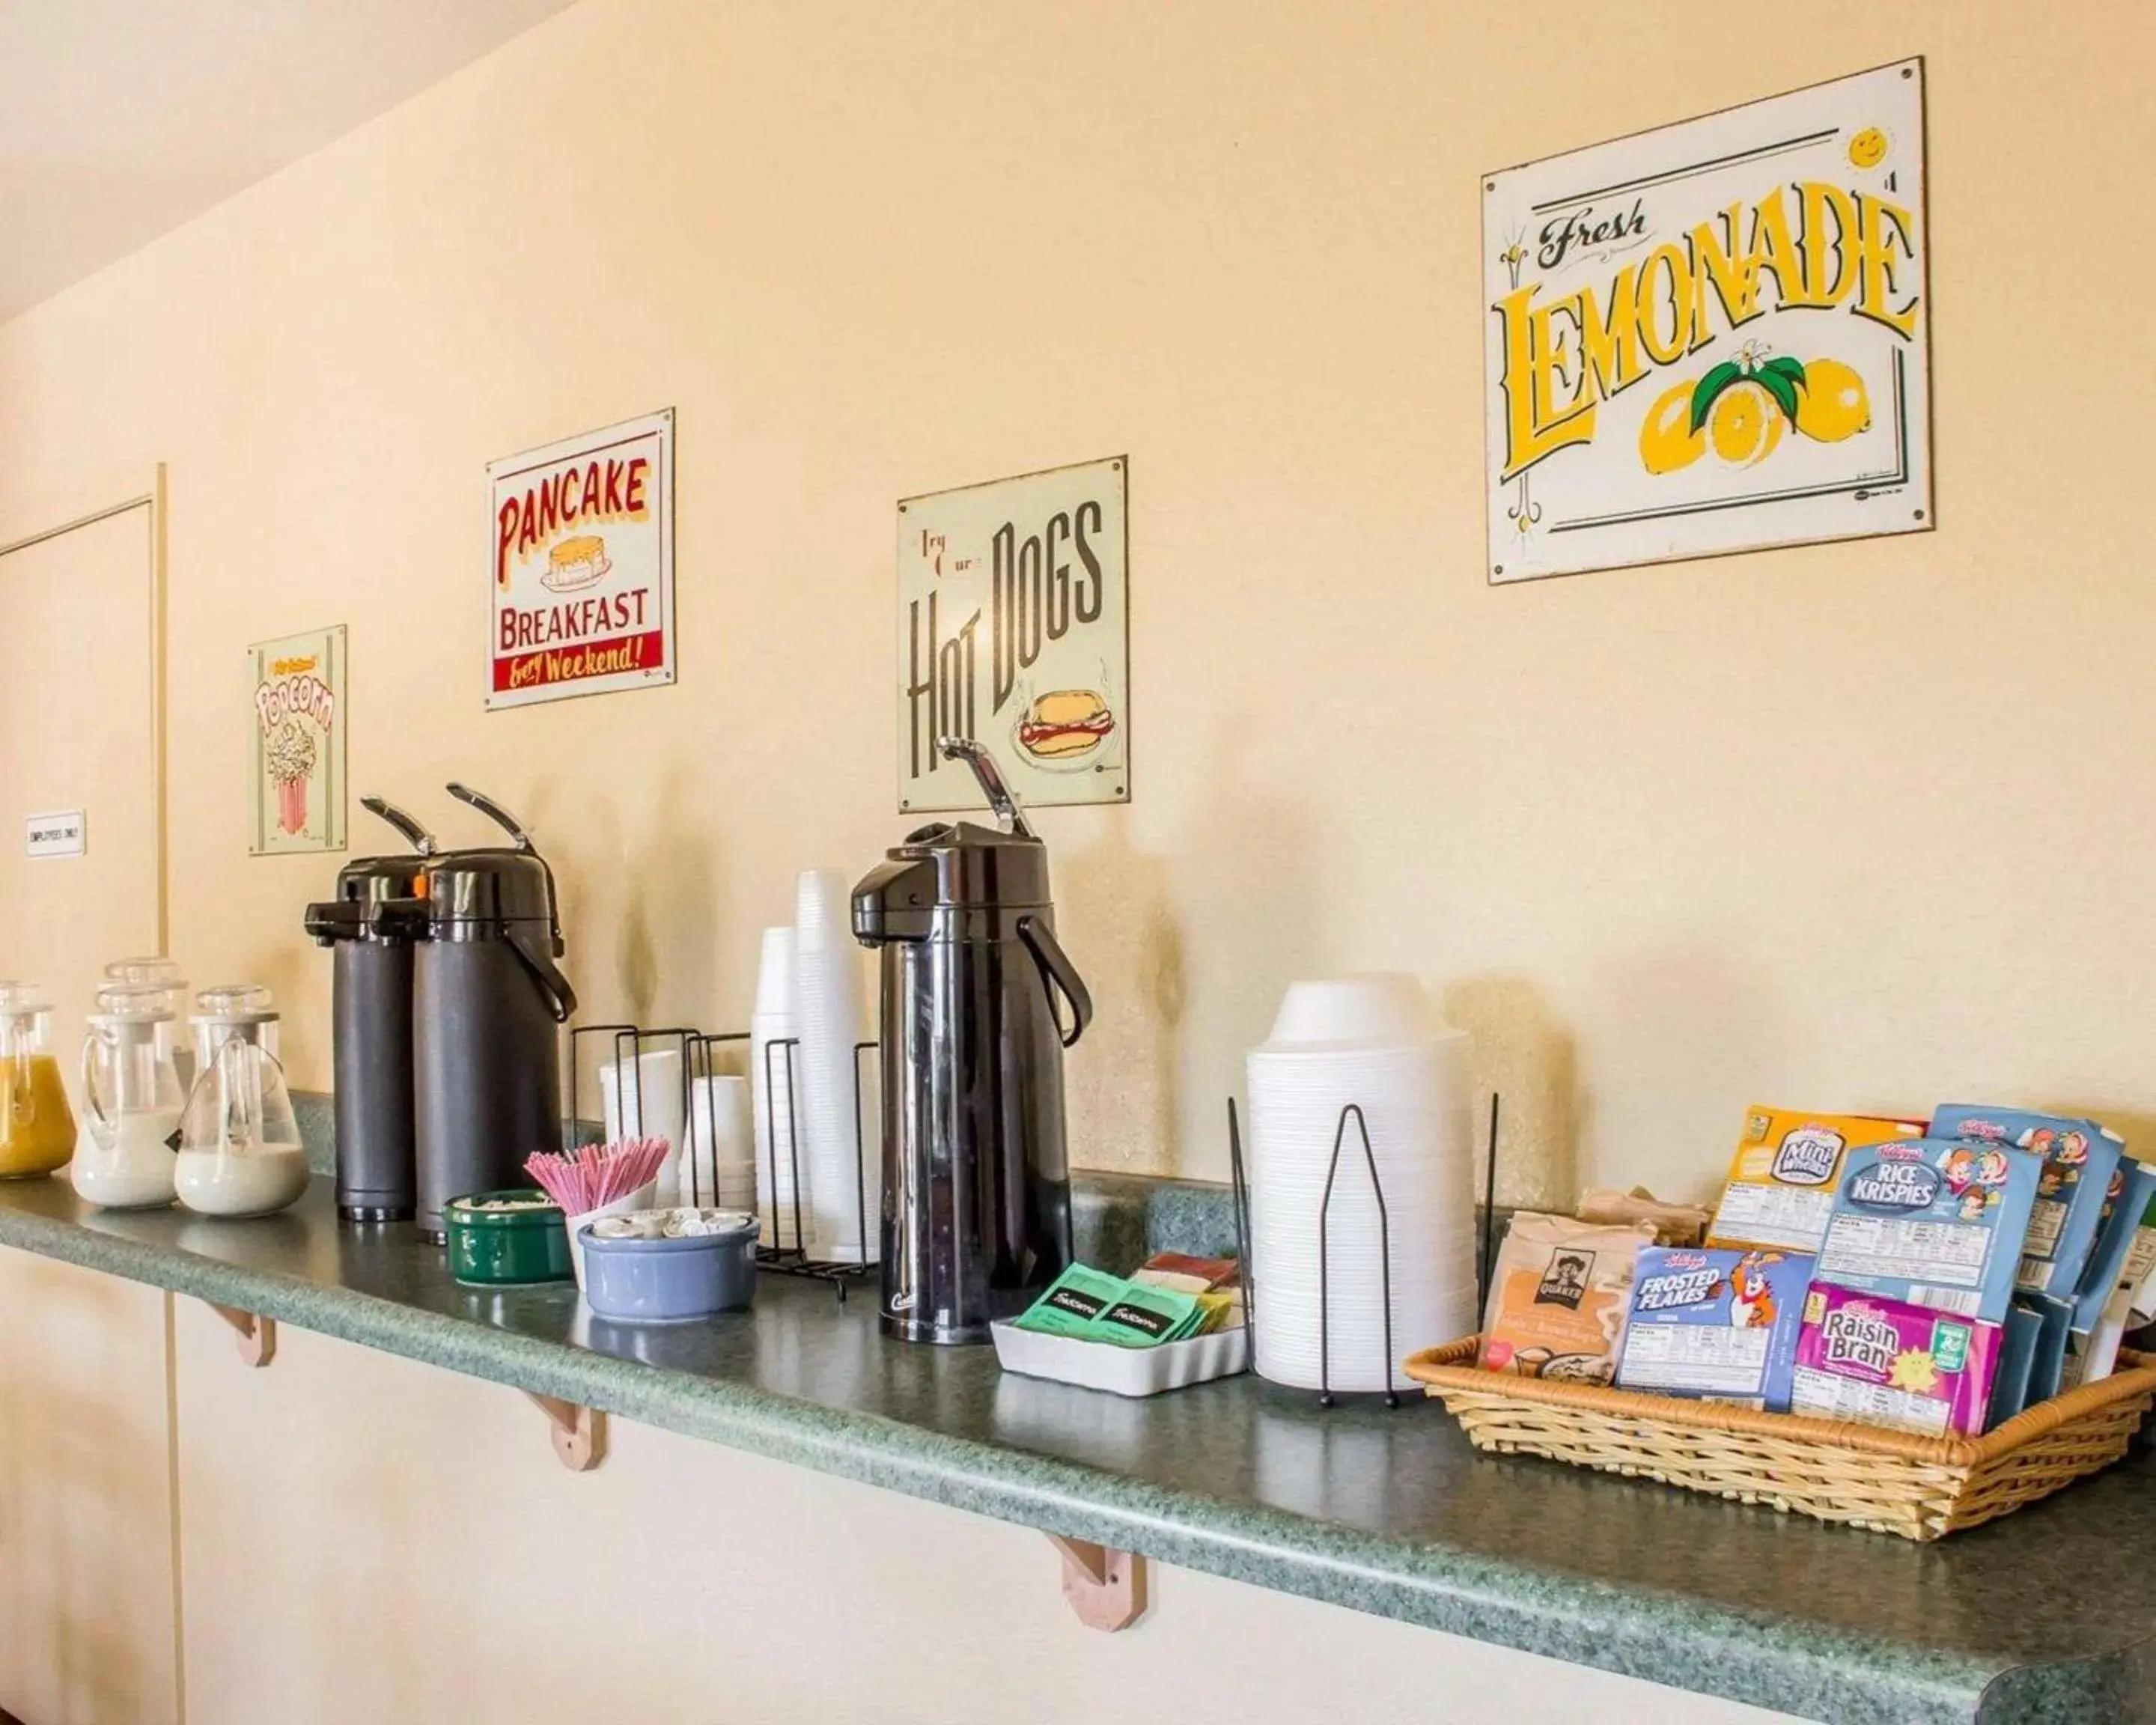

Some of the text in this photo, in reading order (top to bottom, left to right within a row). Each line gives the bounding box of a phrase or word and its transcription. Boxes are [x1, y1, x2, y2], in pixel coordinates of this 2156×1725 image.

[1538, 198, 1646, 270] Fresh
[1492, 181, 1919, 487] LEMONADE
[498, 457, 650, 584] PANCAKE
[500, 588, 648, 651] BREAKFAST
[992, 500, 1103, 717] DOGS
[546, 637, 644, 682] Weekend!
[1851, 1178, 1934, 1206] KRISPIES
[1878, 1163, 1918, 1184] RICE
[1637, 1287, 1707, 1310] FLAKES
[1638, 1268, 1720, 1294] FROSTED
[1828, 1312, 1897, 1350] Raisin
[1831, 1338, 1886, 1369] Bran
